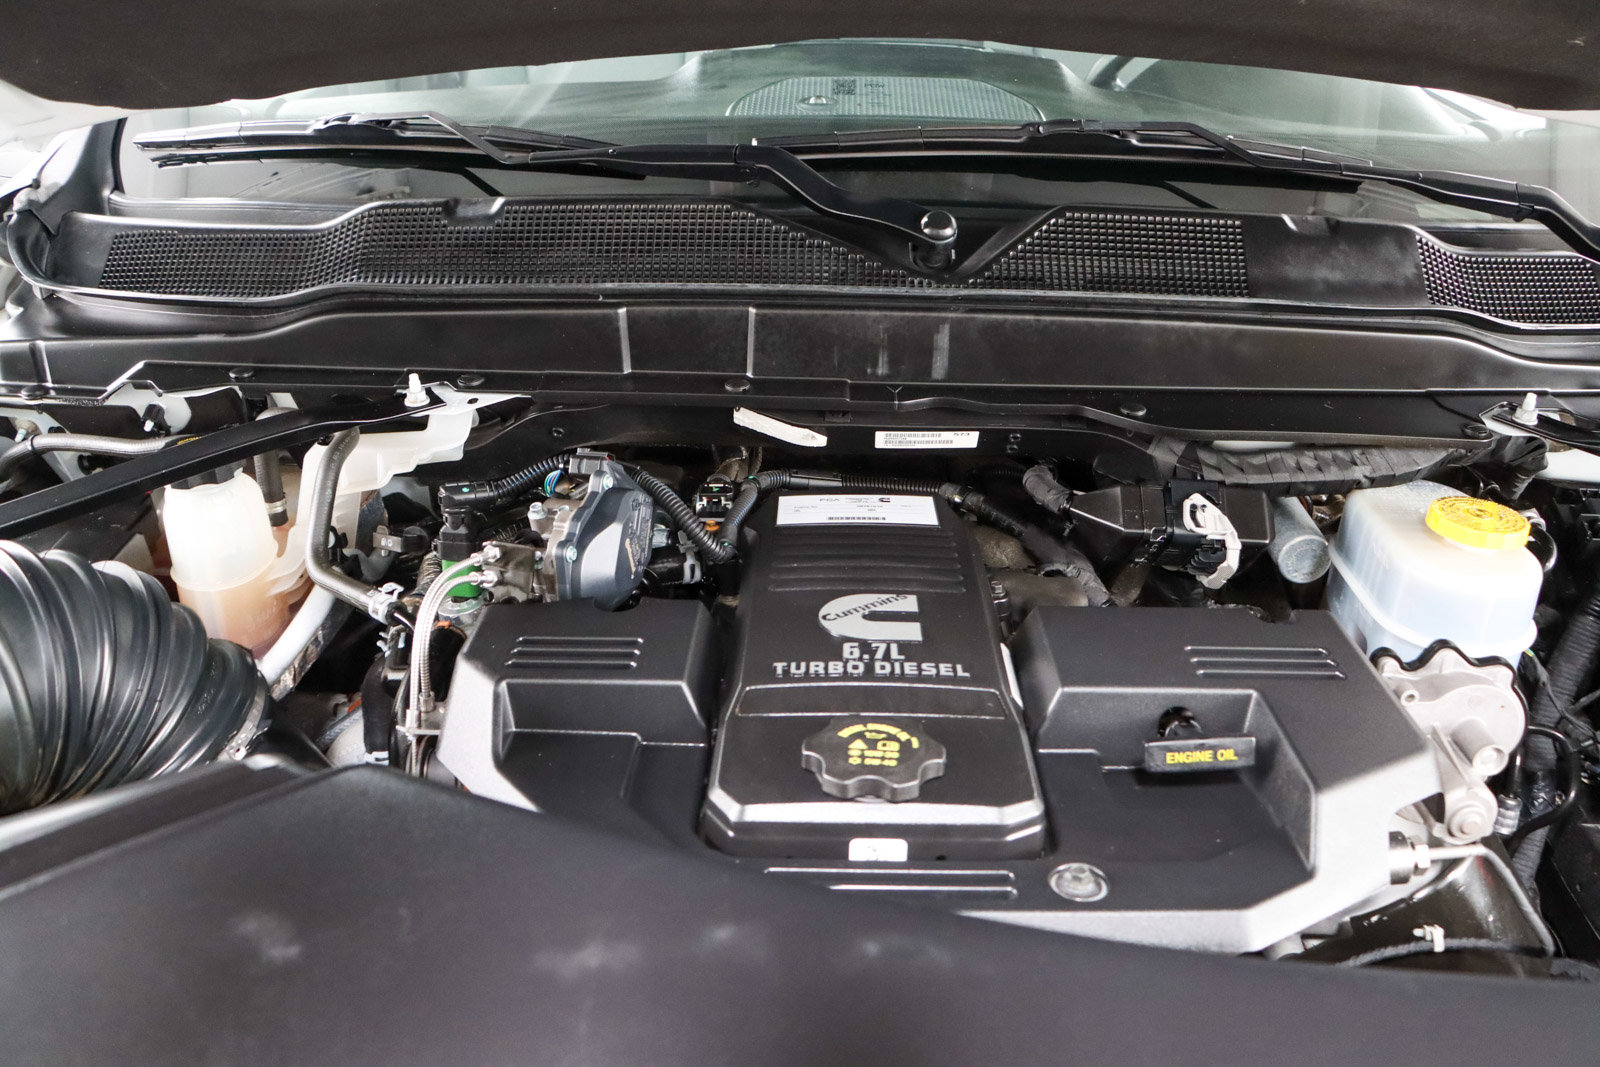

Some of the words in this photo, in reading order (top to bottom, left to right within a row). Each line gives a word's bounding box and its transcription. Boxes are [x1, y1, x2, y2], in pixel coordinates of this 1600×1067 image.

[821, 593, 909, 622] Cummins
[842, 642, 905, 661] 6.7L
[773, 661, 865, 677] TURBO
[874, 661, 971, 679] DIESEL
[1166, 749, 1214, 764] ENGINE
[1217, 748, 1239, 761] OIL
